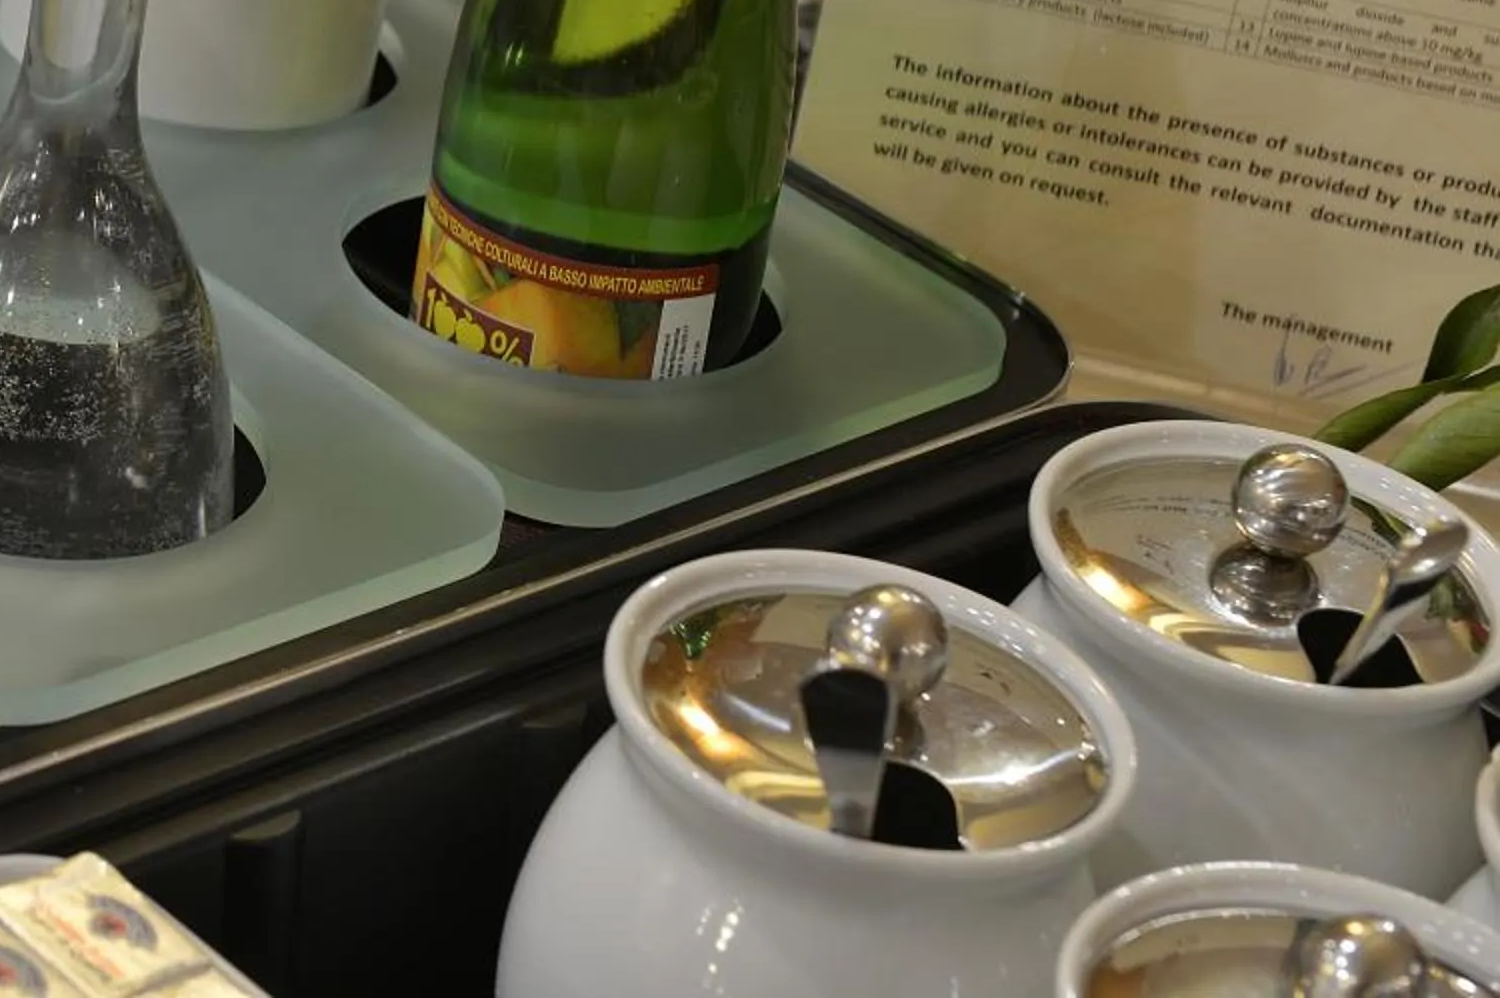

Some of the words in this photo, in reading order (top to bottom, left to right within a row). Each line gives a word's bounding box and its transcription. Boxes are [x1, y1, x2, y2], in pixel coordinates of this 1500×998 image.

[1376, 31, 1417, 47] above
[1430, 23, 1458, 37] and
[1316, 39, 1342, 50] and
[1432, 63, 1493, 82] products
[1326, 60, 1351, 72] and
[1351, 65, 1411, 84] products
[1414, 76, 1457, 94] based
[890, 54, 928, 77] The
[935, 63, 1054, 103] information
[1060, 92, 1119, 117] about
[1126, 104, 1160, 125] the
[1166, 115, 1258, 146] presence
[1264, 136, 1288, 152] of
[1292, 142, 1406, 177] substances
[1412, 167, 1436, 184] or
[871, 142, 909, 162] will
[911, 147, 937, 168] be
[939, 156, 994, 180] given
[997, 170, 1024, 187] on
[1028, 176, 1108, 205] request.
[878, 113, 947, 140] service
[954, 129, 994, 149] and
[999, 139, 1038, 159] you
[1044, 149, 1080, 168] can
[1087, 158, 1161, 185] consult
[1168, 171, 1202, 194] the
[1209, 184, 1294, 213] relevant
[1309, 201, 1465, 250] documentation
[884, 85, 959, 116] causing
[963, 101, 1047, 131] allergies
[1050, 120, 1075, 137] or
[1078, 124, 1202, 164] intolerances
[1206, 153, 1242, 172] can
[1247, 159, 1273, 179] be
[1277, 169, 1371, 199] provided
[1374, 186, 1402, 210] by
[1412, 194, 1447, 216] the
[1451, 205, 1500, 227] staff
[485, 241, 539, 277] COLTURALI
[549, 265, 587, 288] BASSO
[589, 273, 637, 295] IMPATTO
[637, 274, 705, 295] AMBIENTALE
[1222, 302, 1257, 324] The
[1262, 313, 1393, 353] management
